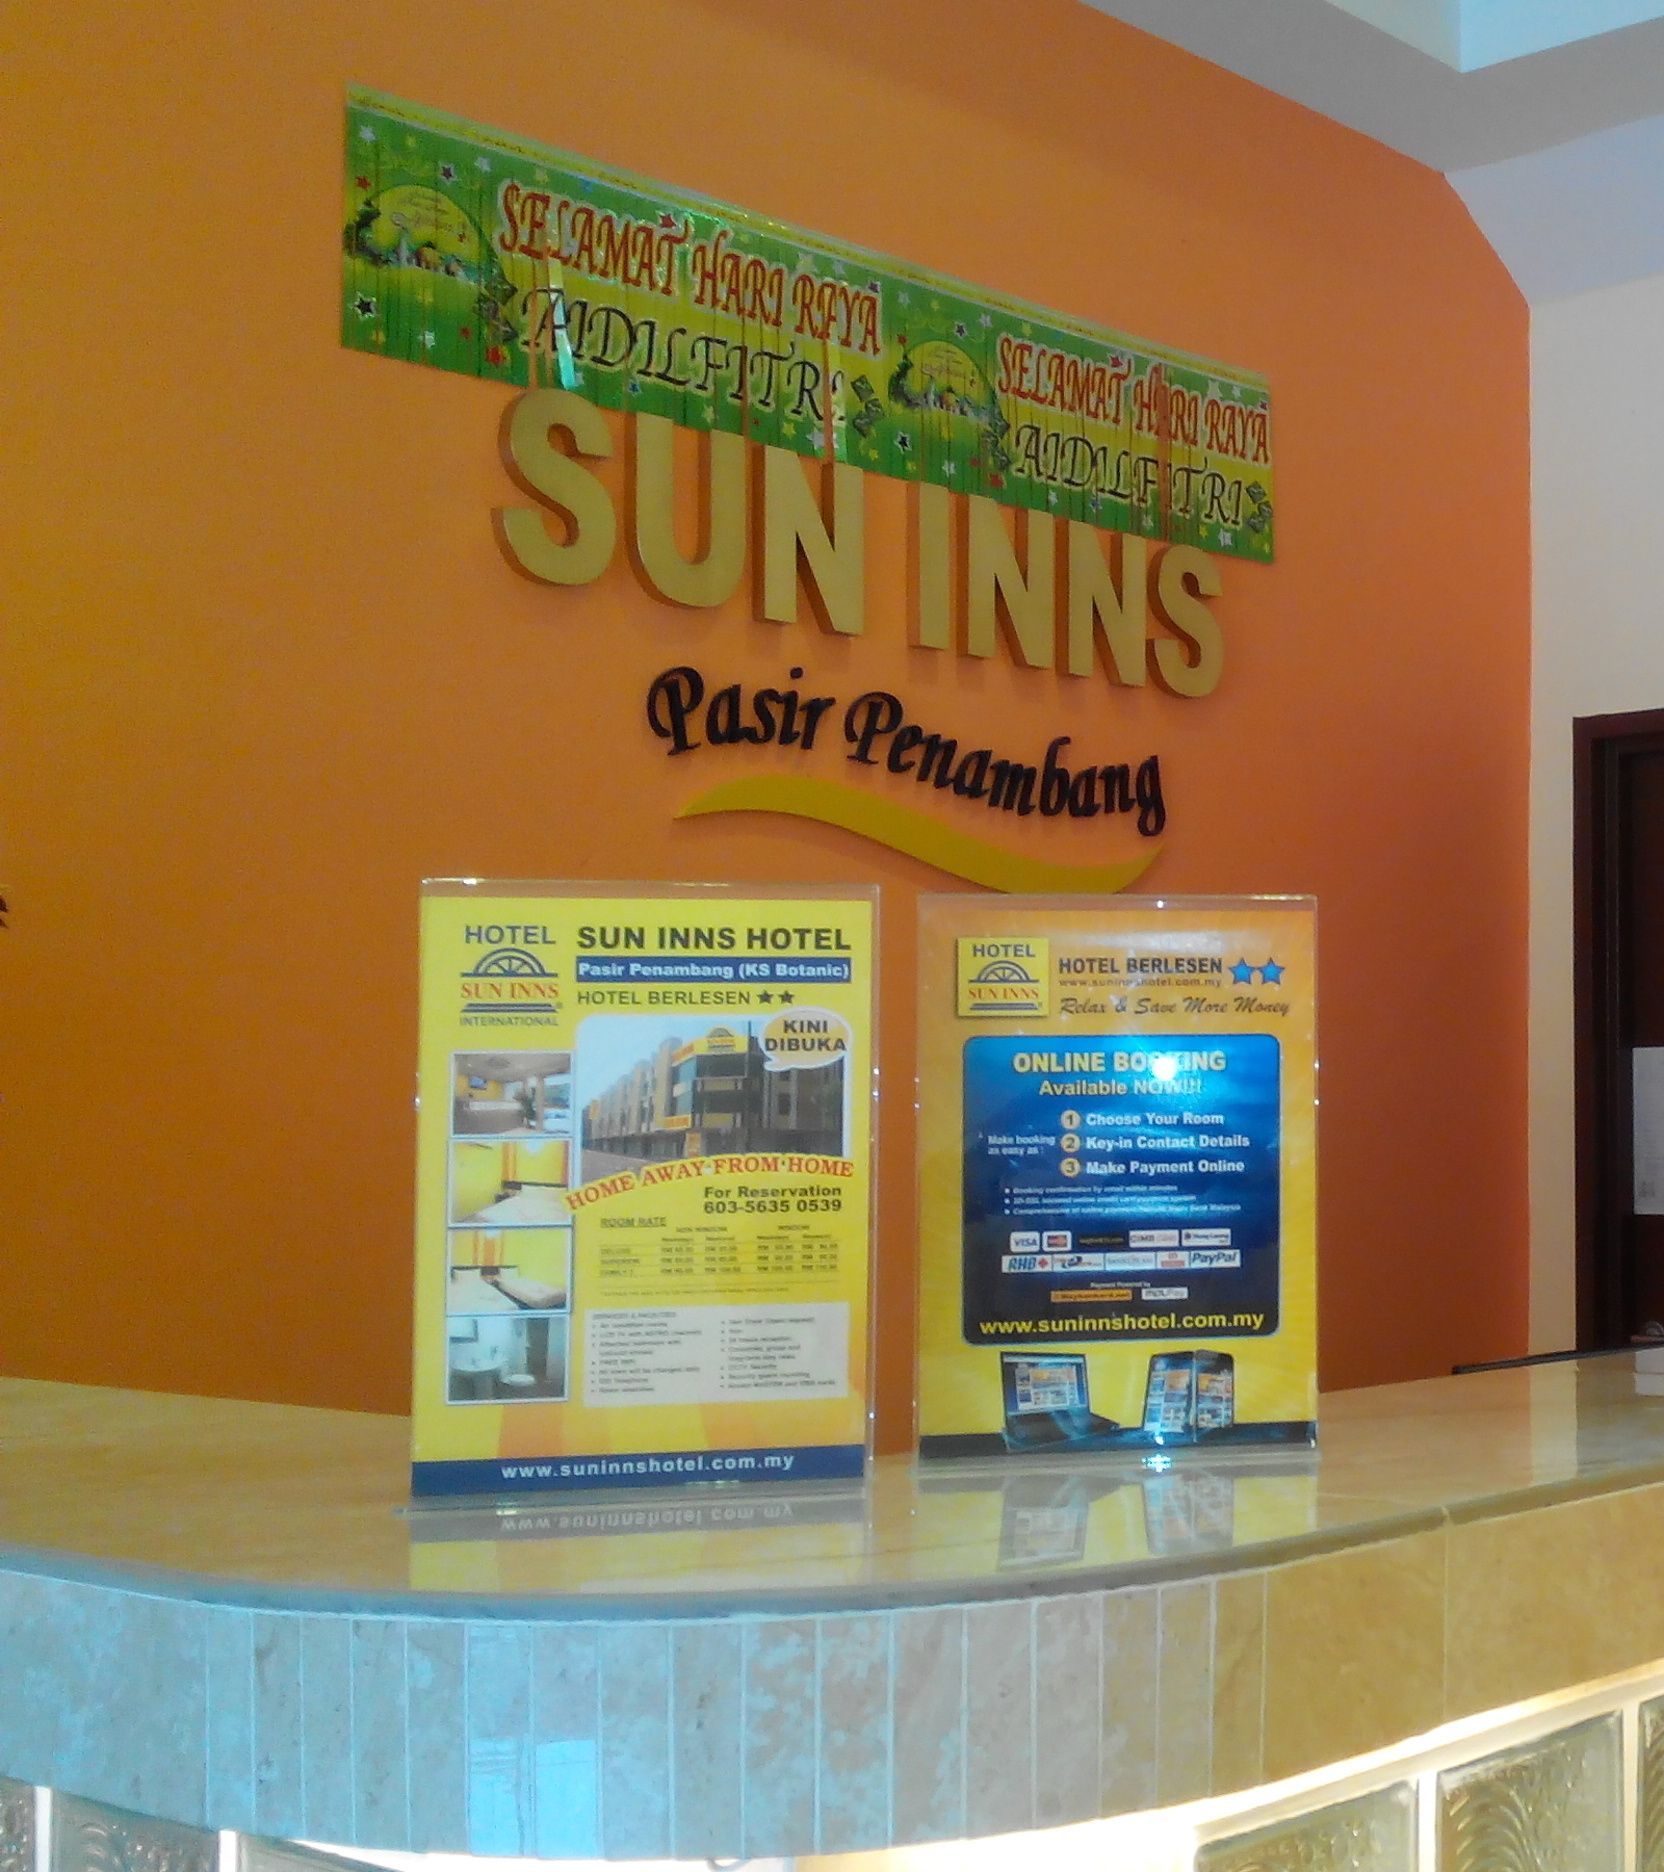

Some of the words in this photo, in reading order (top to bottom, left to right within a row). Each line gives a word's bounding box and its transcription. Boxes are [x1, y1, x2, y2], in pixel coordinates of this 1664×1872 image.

[498, 182, 692, 296] SELAMAT
[693, 229, 784, 328] HARI
[998, 337, 1132, 425] SELAMAT
[1205, 398, 1269, 464] RAYA
[491, 387, 865, 637] SUN
[910, 482, 1224, 698] INNS
[647, 666, 835, 756] Pasir
[844, 691, 1167, 837] Penambang
[465, 924, 556, 945] HOTEL
[577, 927, 645, 950] SUN
[658, 927, 736, 950] INNS
[746, 926, 851, 950] HOTEL
[973, 944, 1036, 958] HOTEL
[578, 962, 624, 978] Pasir
[630, 962, 734, 980] Penambang
[739, 961, 771, 979] (KS
[776, 961, 850, 979] Botanic)
[1058, 957, 1120, 974] HOTEL
[1126, 957, 1222, 974] BERLESEN
[460, 982, 503, 999] SUN
[510, 982, 560, 999] INNS
[577, 990, 642, 1006] HOTEL
[649, 990, 751, 1005] BERLESEN
[968, 986, 997, 999] SUN
[1003, 986, 1040, 999] INNS
[1060, 997, 1107, 1015] Relax
[1114, 997, 1127, 1014] &
[1133, 997, 1177, 1015] Save
[1182, 996, 1228, 1014] More
[1232, 996, 1291, 1017] Money
[459, 1015, 559, 1027] INTERNATIONAL
[783, 1019, 830, 1035] KINI
[764, 1036, 847, 1053] DIBUKA
[1012, 1051, 1106, 1073] ONLINE
[1039, 1079, 1128, 1096] Available
[1086, 1112, 1141, 1126] Choose
[1146, 1112, 1181, 1125] Your
[1183, 1112, 1224, 1125] Room
[1086, 1136, 1132, 1152] Key-in
[1137, 1135, 1196, 1149] Contact
[1199, 1134, 1250, 1148] Details
[1086, 1161, 1125, 1174] Make
[1130, 1160, 1193, 1176] Payment
[1198, 1158, 1245, 1172] Online
[565, 1173, 636, 1211] HOME
[640, 1160, 706, 1187] AWAY
[788, 1156, 855, 1178] HOME
[704, 1186, 732, 1199] For
[738, 1184, 842, 1198] Reservation
[704, 1200, 790, 1215] 603-5635
[796, 1199, 842, 1213] 0539
[639, 1216, 667, 1227] RATE
[1014, 1237, 1037, 1246] VISA
[1008, 1257, 1035, 1270] RHB
[1192, 1251, 1237, 1265] PayPal
[979, 1312, 1265, 1335] www.suninnshotel.com.my
[501, 1453, 795, 1479] www.suninnshotel.com.my
